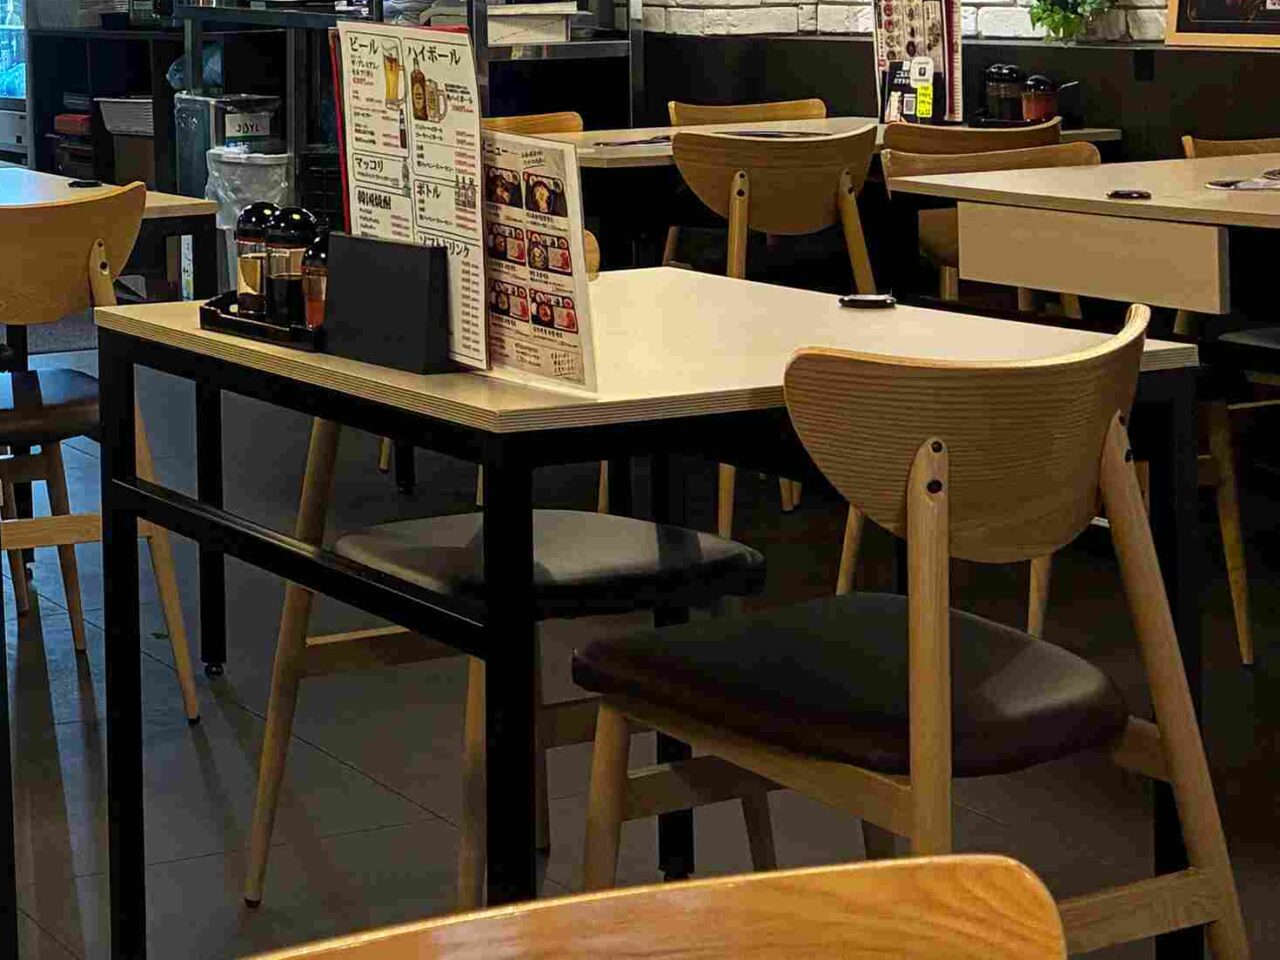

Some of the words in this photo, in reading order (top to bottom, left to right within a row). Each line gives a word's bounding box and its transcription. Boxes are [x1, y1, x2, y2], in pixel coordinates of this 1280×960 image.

[349, 36, 379, 55] ビール
[406, 44, 461, 66] ハイボール
[355, 157, 384, 173] マッコリ
[417, 182, 441, 199] ボトル
